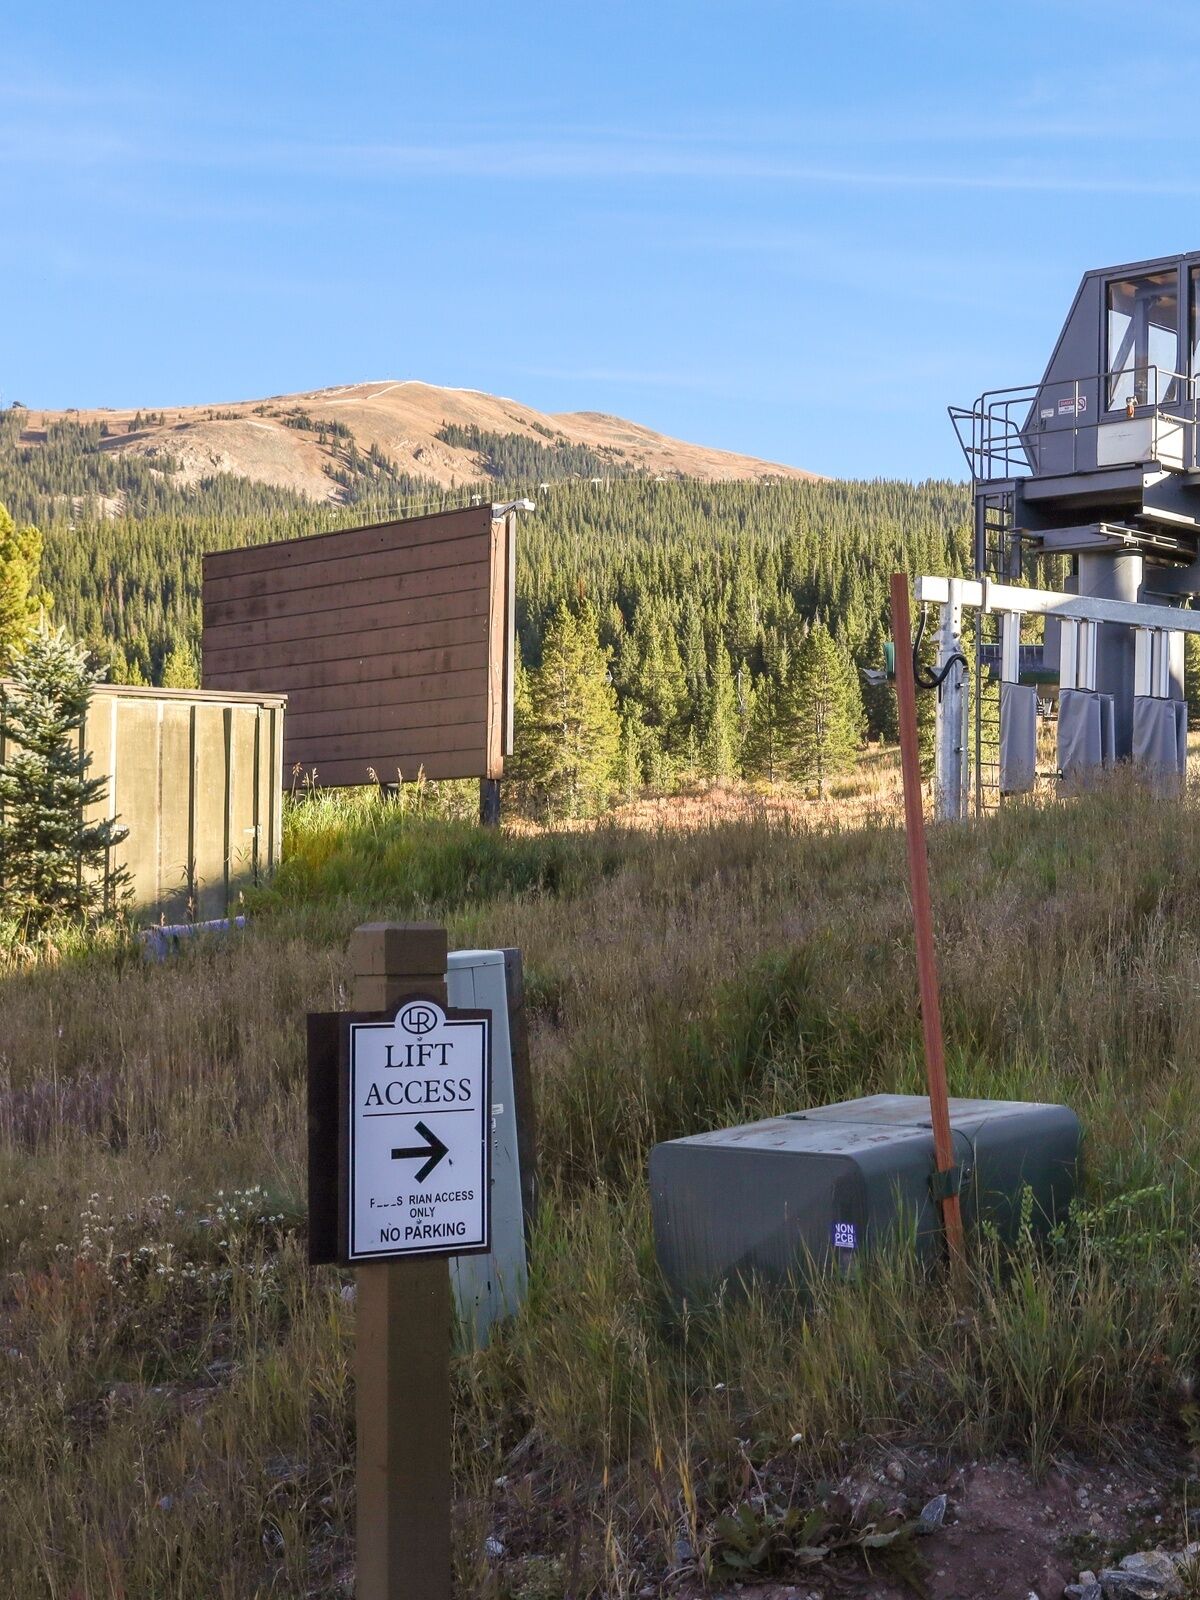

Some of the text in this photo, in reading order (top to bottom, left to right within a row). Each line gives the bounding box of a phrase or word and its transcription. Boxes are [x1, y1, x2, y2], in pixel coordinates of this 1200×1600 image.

[384, 1043, 454, 1068] LIFT
[364, 1078, 471, 1106] ACCESS
[434, 1190, 474, 1203] ACCESS
[409, 1207, 435, 1218] ONLY
[380, 1222, 466, 1243] NO PARKING
[835, 1223, 854, 1234] NON
[835, 1232, 854, 1243] PCB
